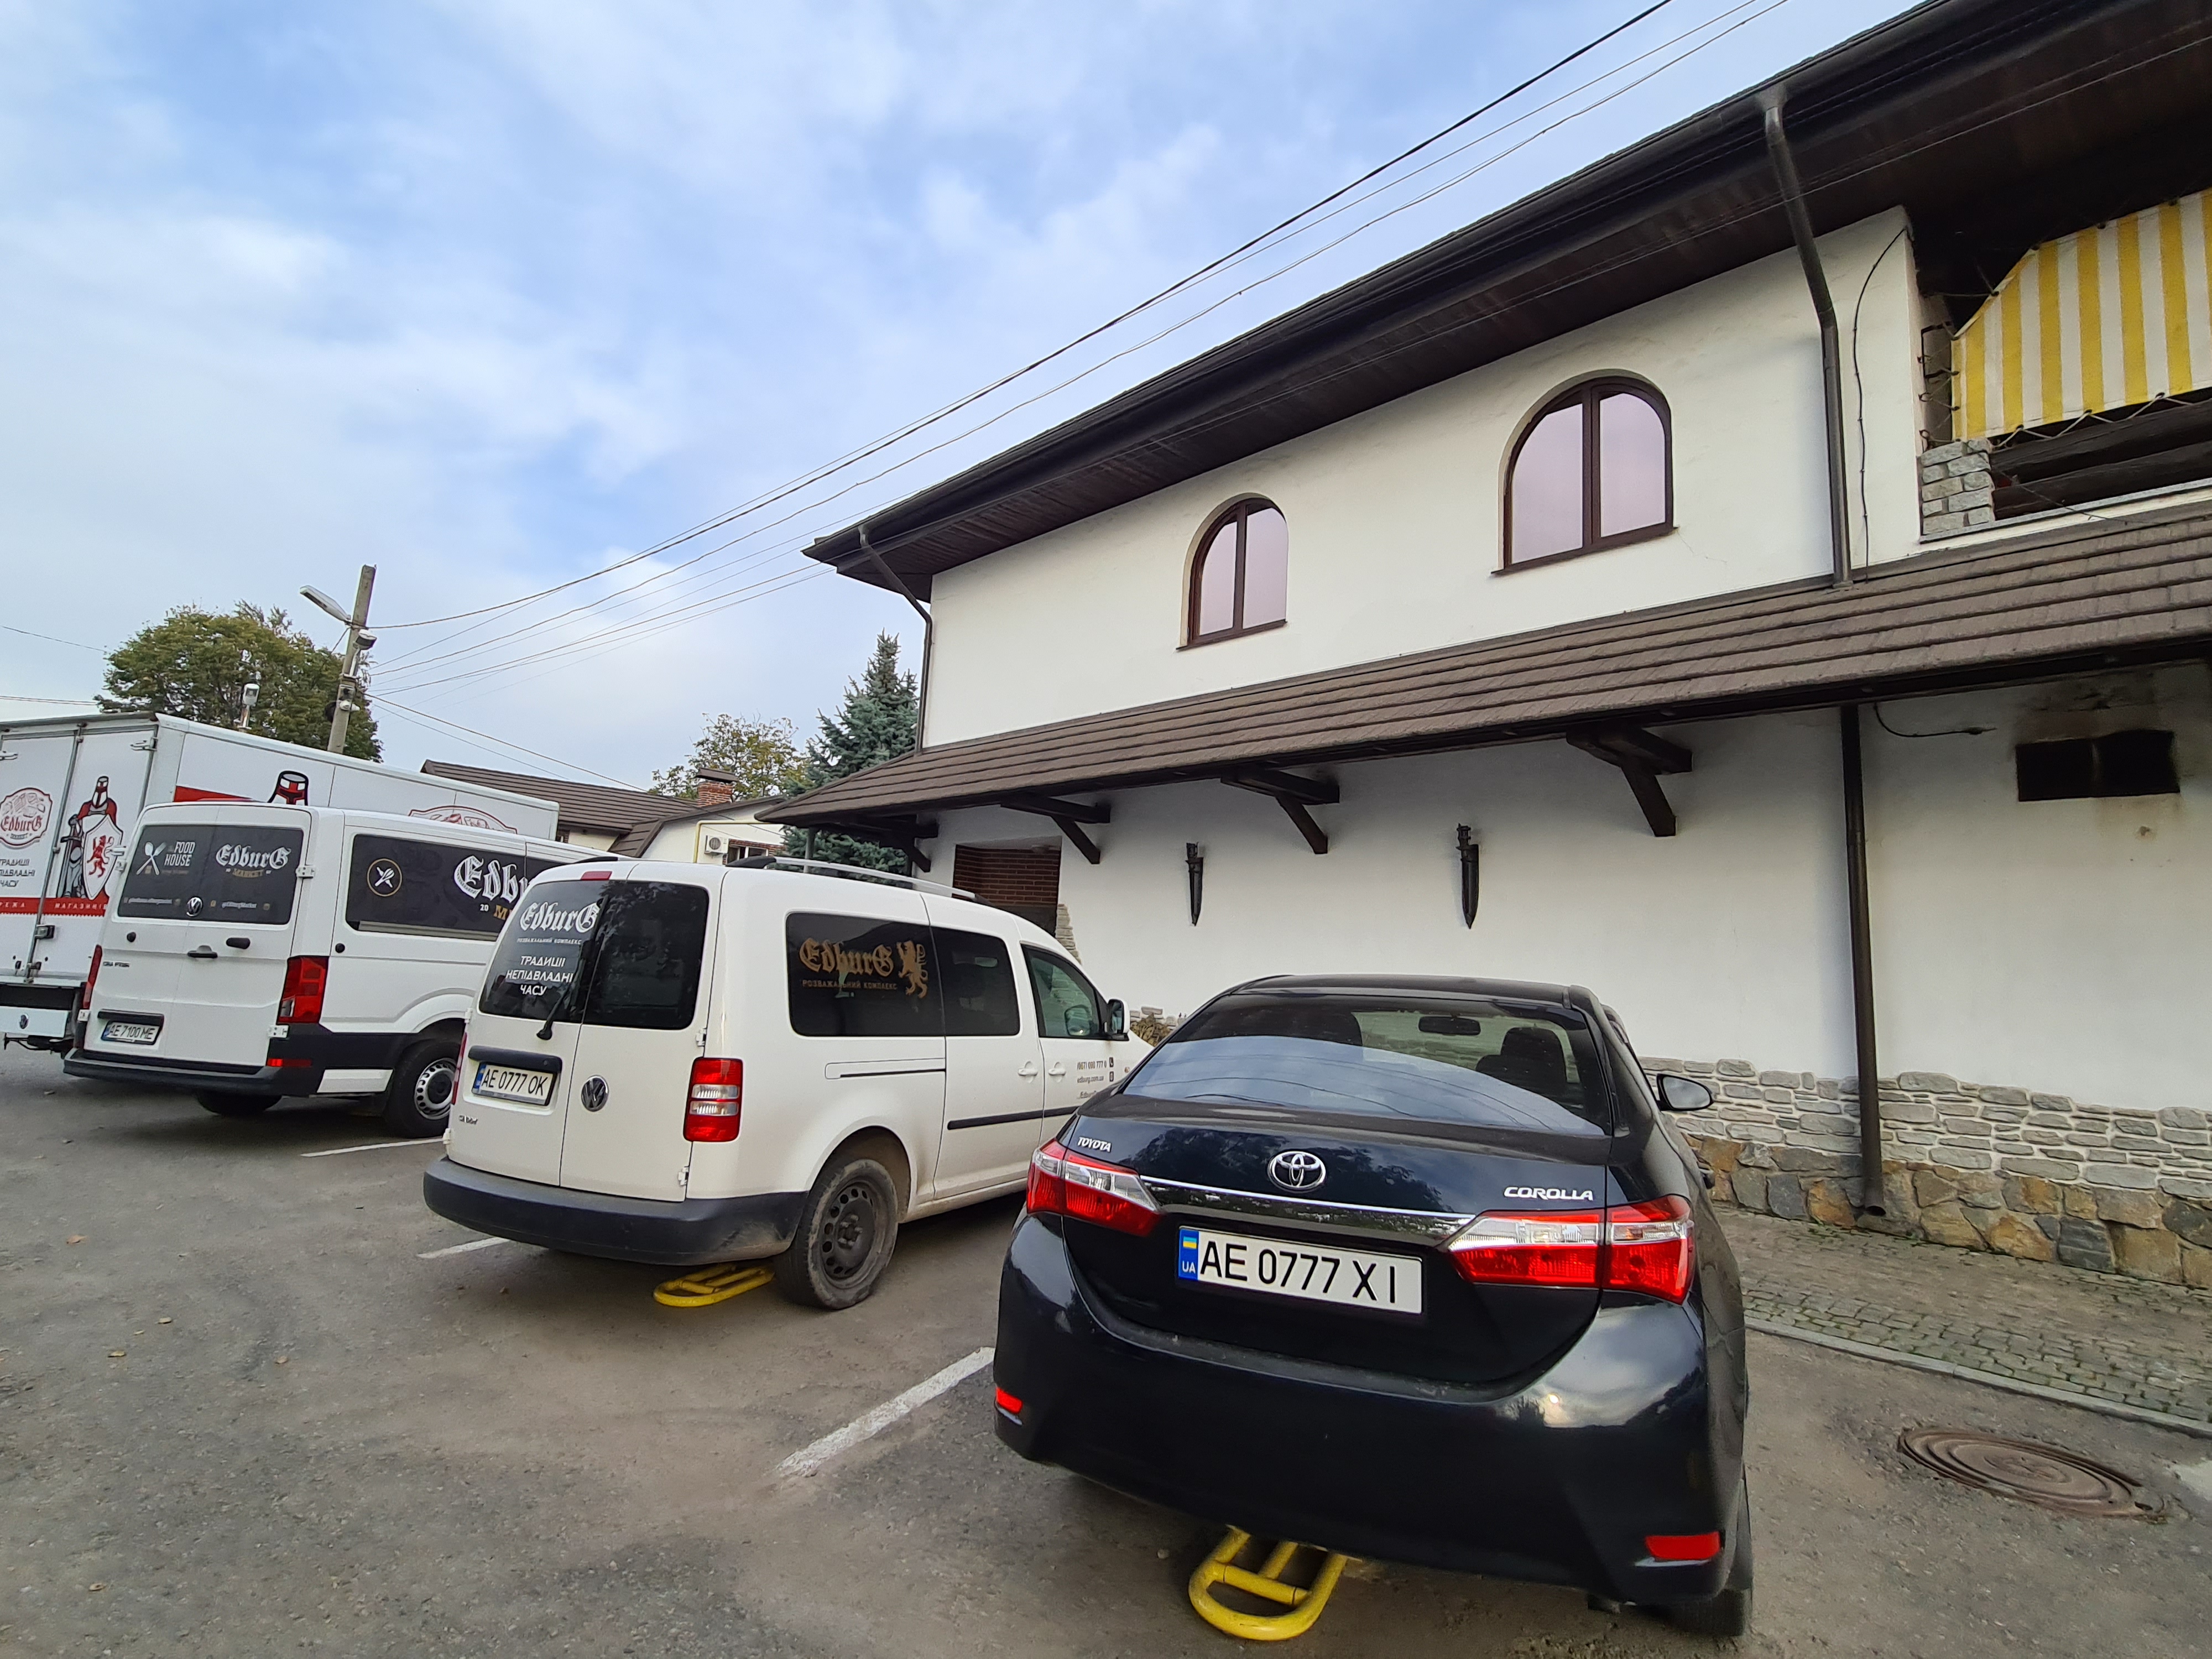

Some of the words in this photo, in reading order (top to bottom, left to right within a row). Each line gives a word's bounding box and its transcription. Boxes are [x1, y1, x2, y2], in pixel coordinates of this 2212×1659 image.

[174, 841, 196, 853] FOOD
[164, 853, 192, 867] HOUSE
[480, 904, 489, 912] 20
[505, 969, 574, 983] НЕПІДВЛАДНІ
[520, 984, 547, 996] ЧАСУ
[110, 1024, 122, 1036] AE
[120, 1025, 141, 1038] 7100
[140, 1027, 155, 1039] ME
[482, 1069, 499, 1088] AE
[498, 1071, 528, 1093] 0777
[528, 1076, 548, 1096] OK
[1078, 1136, 1111, 1152] TOYOTA
[1504, 1186, 1594, 1201] COROLLA
[1182, 1260, 1196, 1274] UA
[1200, 1240, 1248, 1282] AE
[1259, 1248, 1340, 1293] 0777
